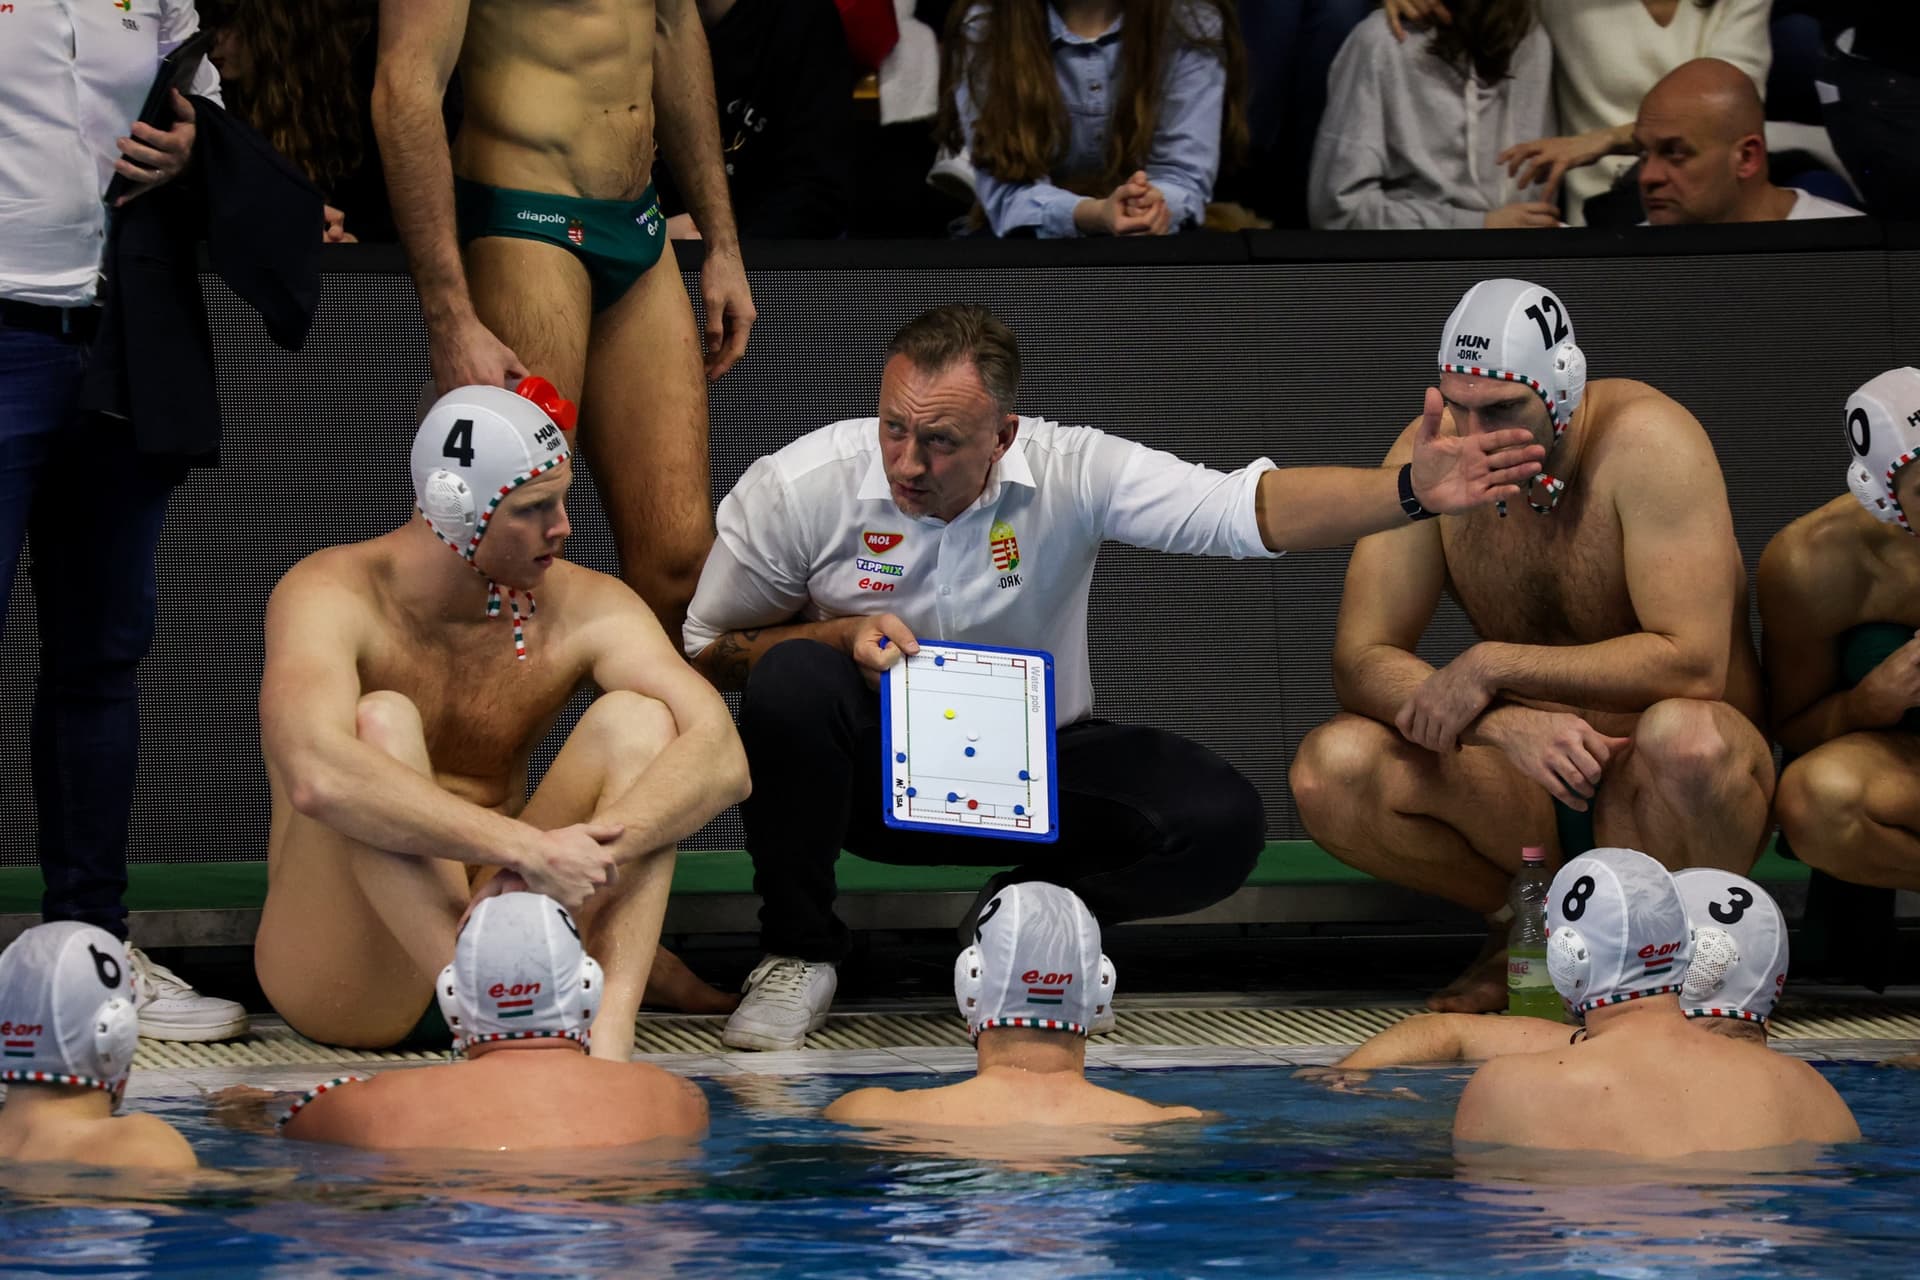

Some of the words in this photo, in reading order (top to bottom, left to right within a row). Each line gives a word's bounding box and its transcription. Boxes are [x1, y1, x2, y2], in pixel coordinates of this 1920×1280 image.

[517, 210, 566, 224] diapolo
[1456, 335, 1490, 350] HUN
[1525, 296, 1569, 350] 12
[443, 419, 475, 467] 4
[868, 535, 890, 545] MOL
[1562, 875, 1595, 921] 8
[1709, 887, 1753, 924] 3
[88, 943, 121, 989] 6
